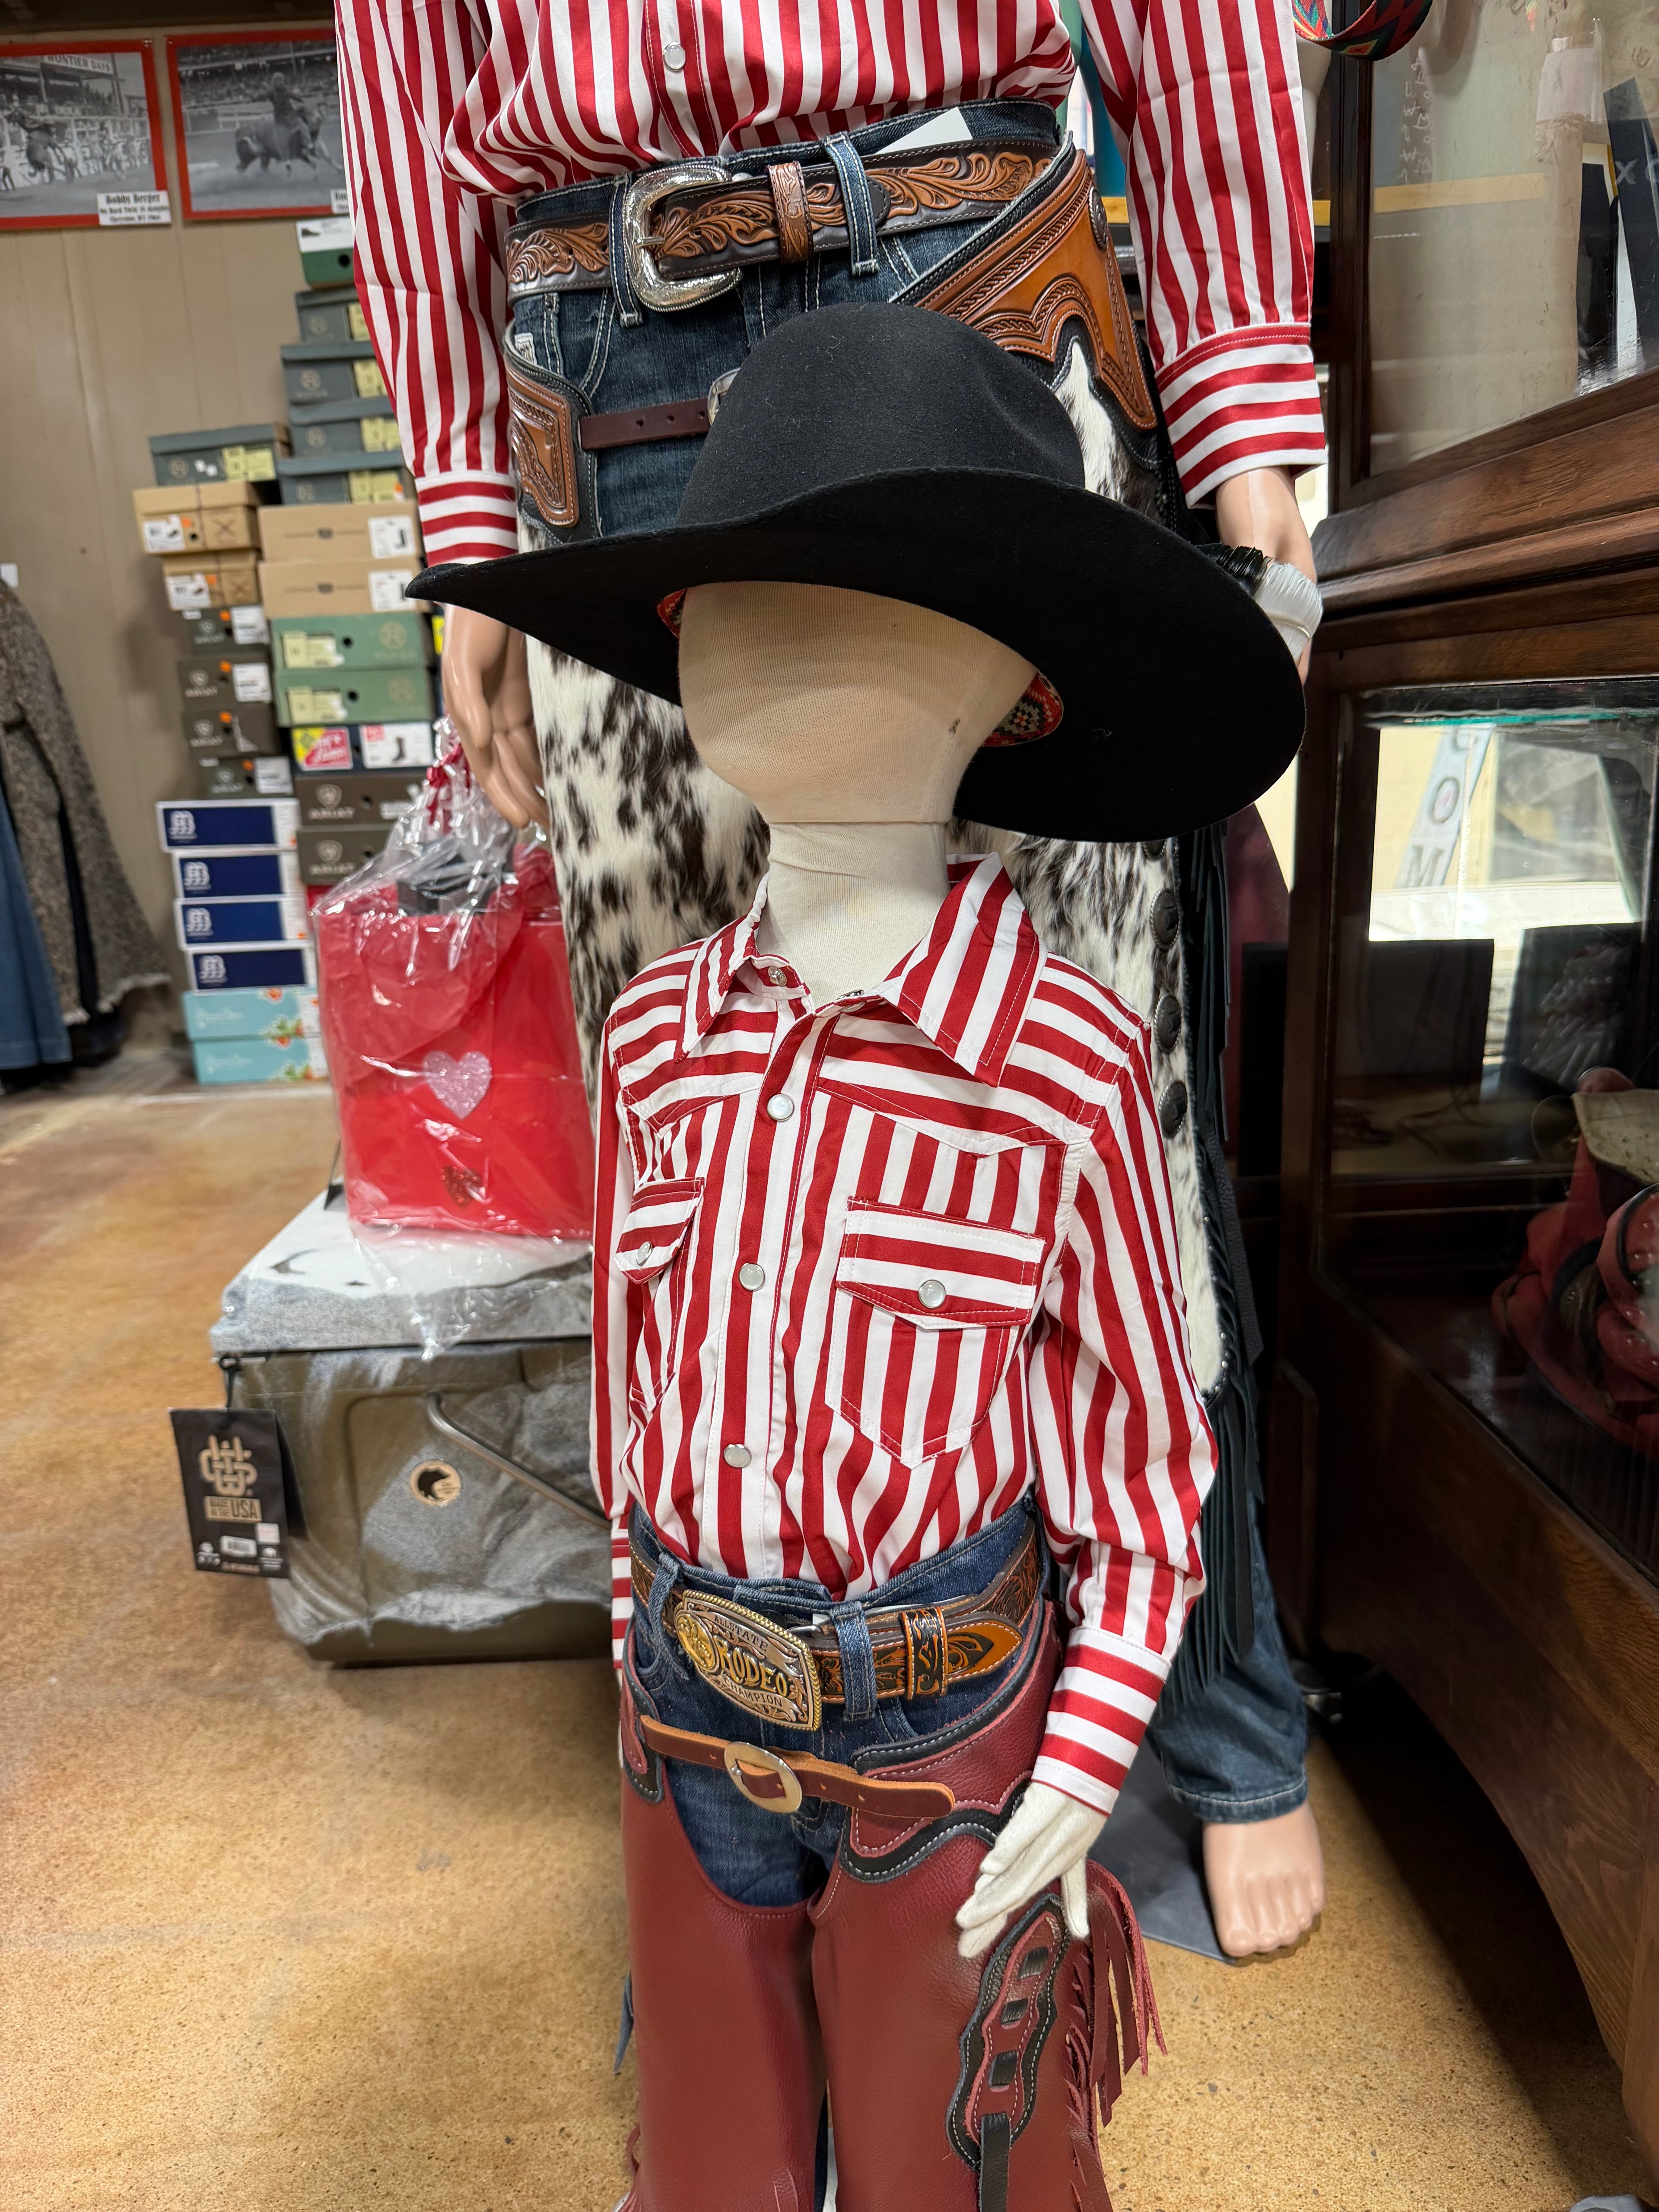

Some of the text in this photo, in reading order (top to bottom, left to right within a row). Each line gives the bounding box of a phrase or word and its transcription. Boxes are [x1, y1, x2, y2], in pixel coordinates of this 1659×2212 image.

[230, 1499, 258, 1519] USA
[714, 1615, 768, 1652] ALLSTATE
[714, 1636, 788, 1697] RODEO
[725, 1678, 783, 1707] CHAMPION
